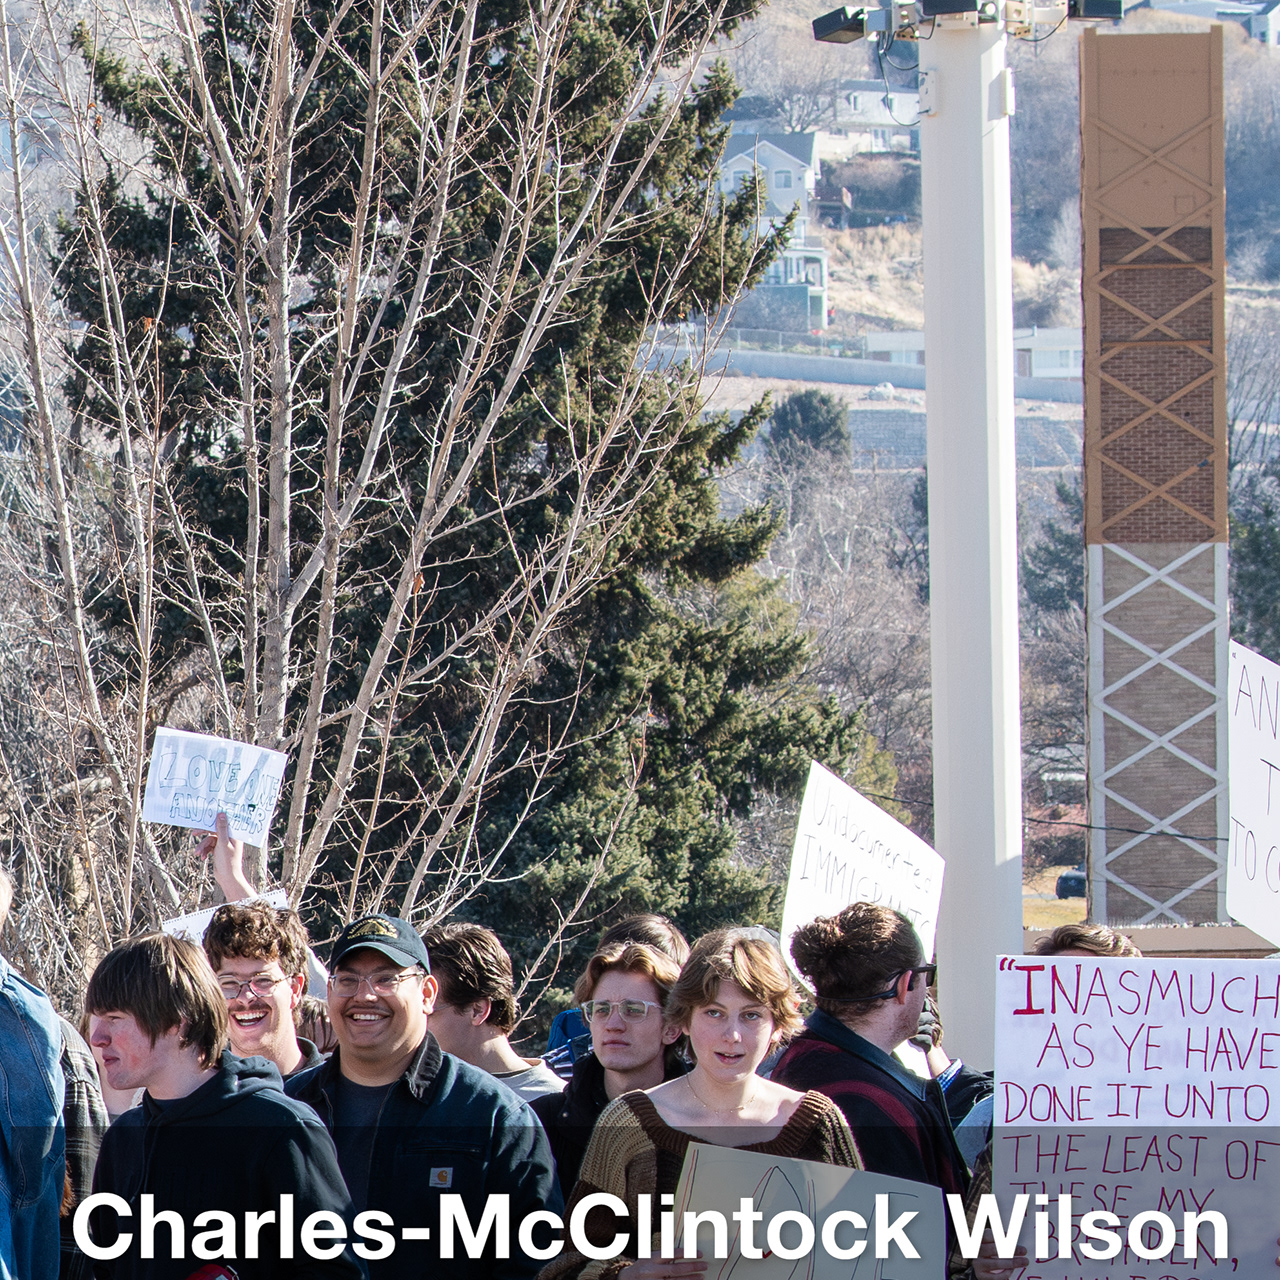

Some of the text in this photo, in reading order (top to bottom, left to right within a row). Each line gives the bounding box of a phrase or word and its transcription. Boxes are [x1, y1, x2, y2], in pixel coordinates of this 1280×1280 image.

[158, 752, 280, 812] LOVE ONE
[170, 793, 268, 835] ANOTHER
[1037, 1023, 1280, 1073] AS YE HAVE
[999, 1081, 1270, 1124] DONE IT UNTO
[1002, 1134, 1280, 1181] THE LEAST OF
[1157, 1186, 1215, 1226] MY
